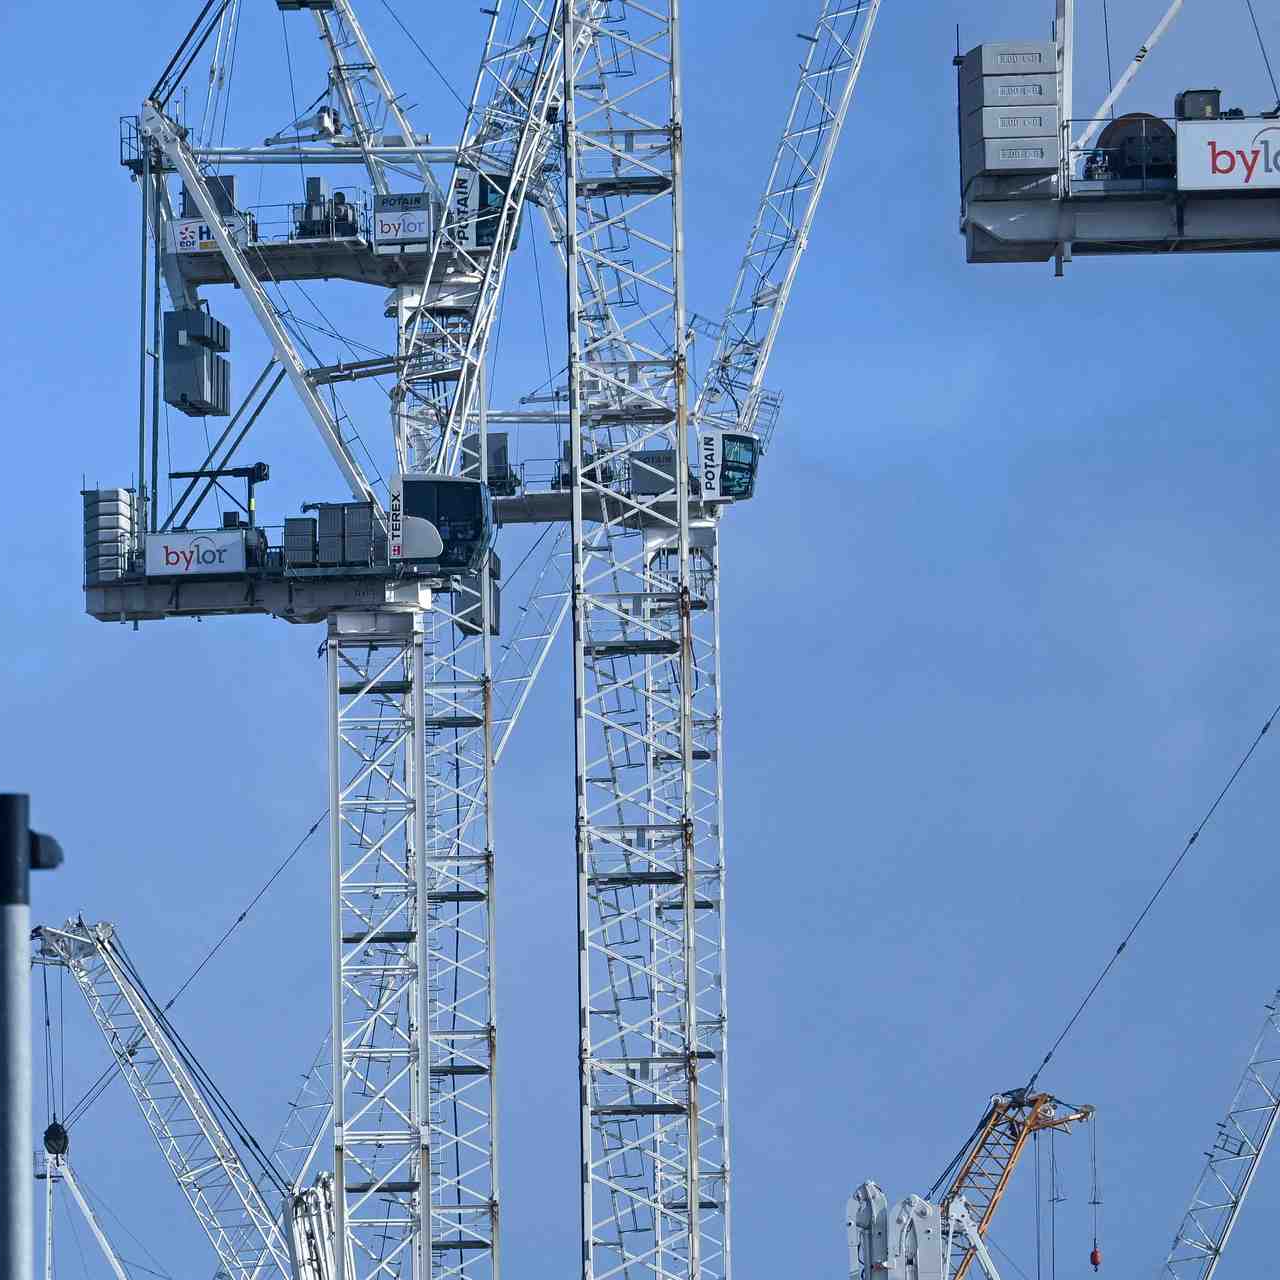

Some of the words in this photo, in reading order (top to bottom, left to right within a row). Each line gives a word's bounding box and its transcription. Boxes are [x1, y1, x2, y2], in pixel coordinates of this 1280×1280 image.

[380, 220, 424, 236] bylor
[457, 178, 469, 241] POTAIN
[703, 436, 715, 491] POTAIN
[391, 492, 401, 541] TEREX
[163, 544, 228, 571] bylor
